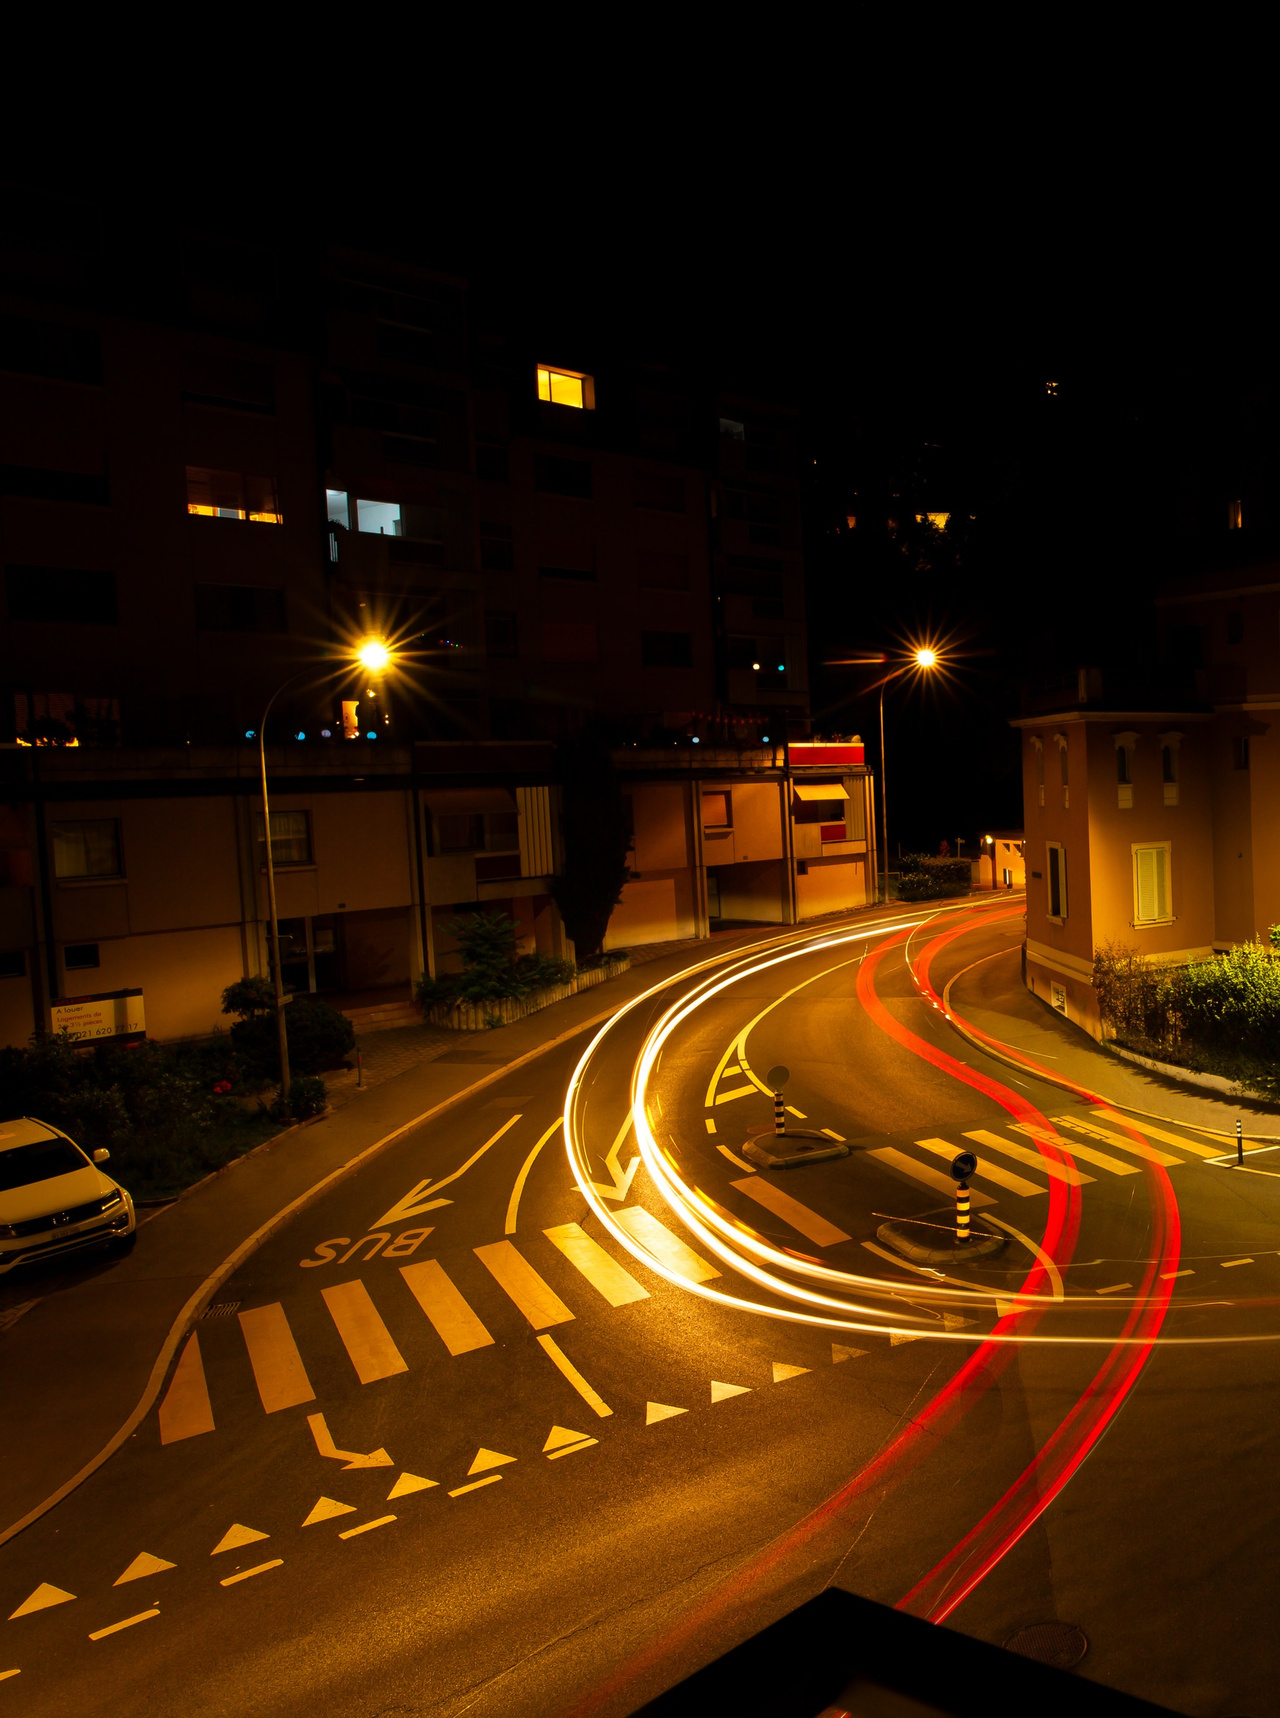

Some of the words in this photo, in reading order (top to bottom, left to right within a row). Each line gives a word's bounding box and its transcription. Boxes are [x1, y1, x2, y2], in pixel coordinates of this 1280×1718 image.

[95, 1027, 112, 1035] 620
[128, 1023, 139, 1031] 17
[298, 1226, 436, 1268] BUS
